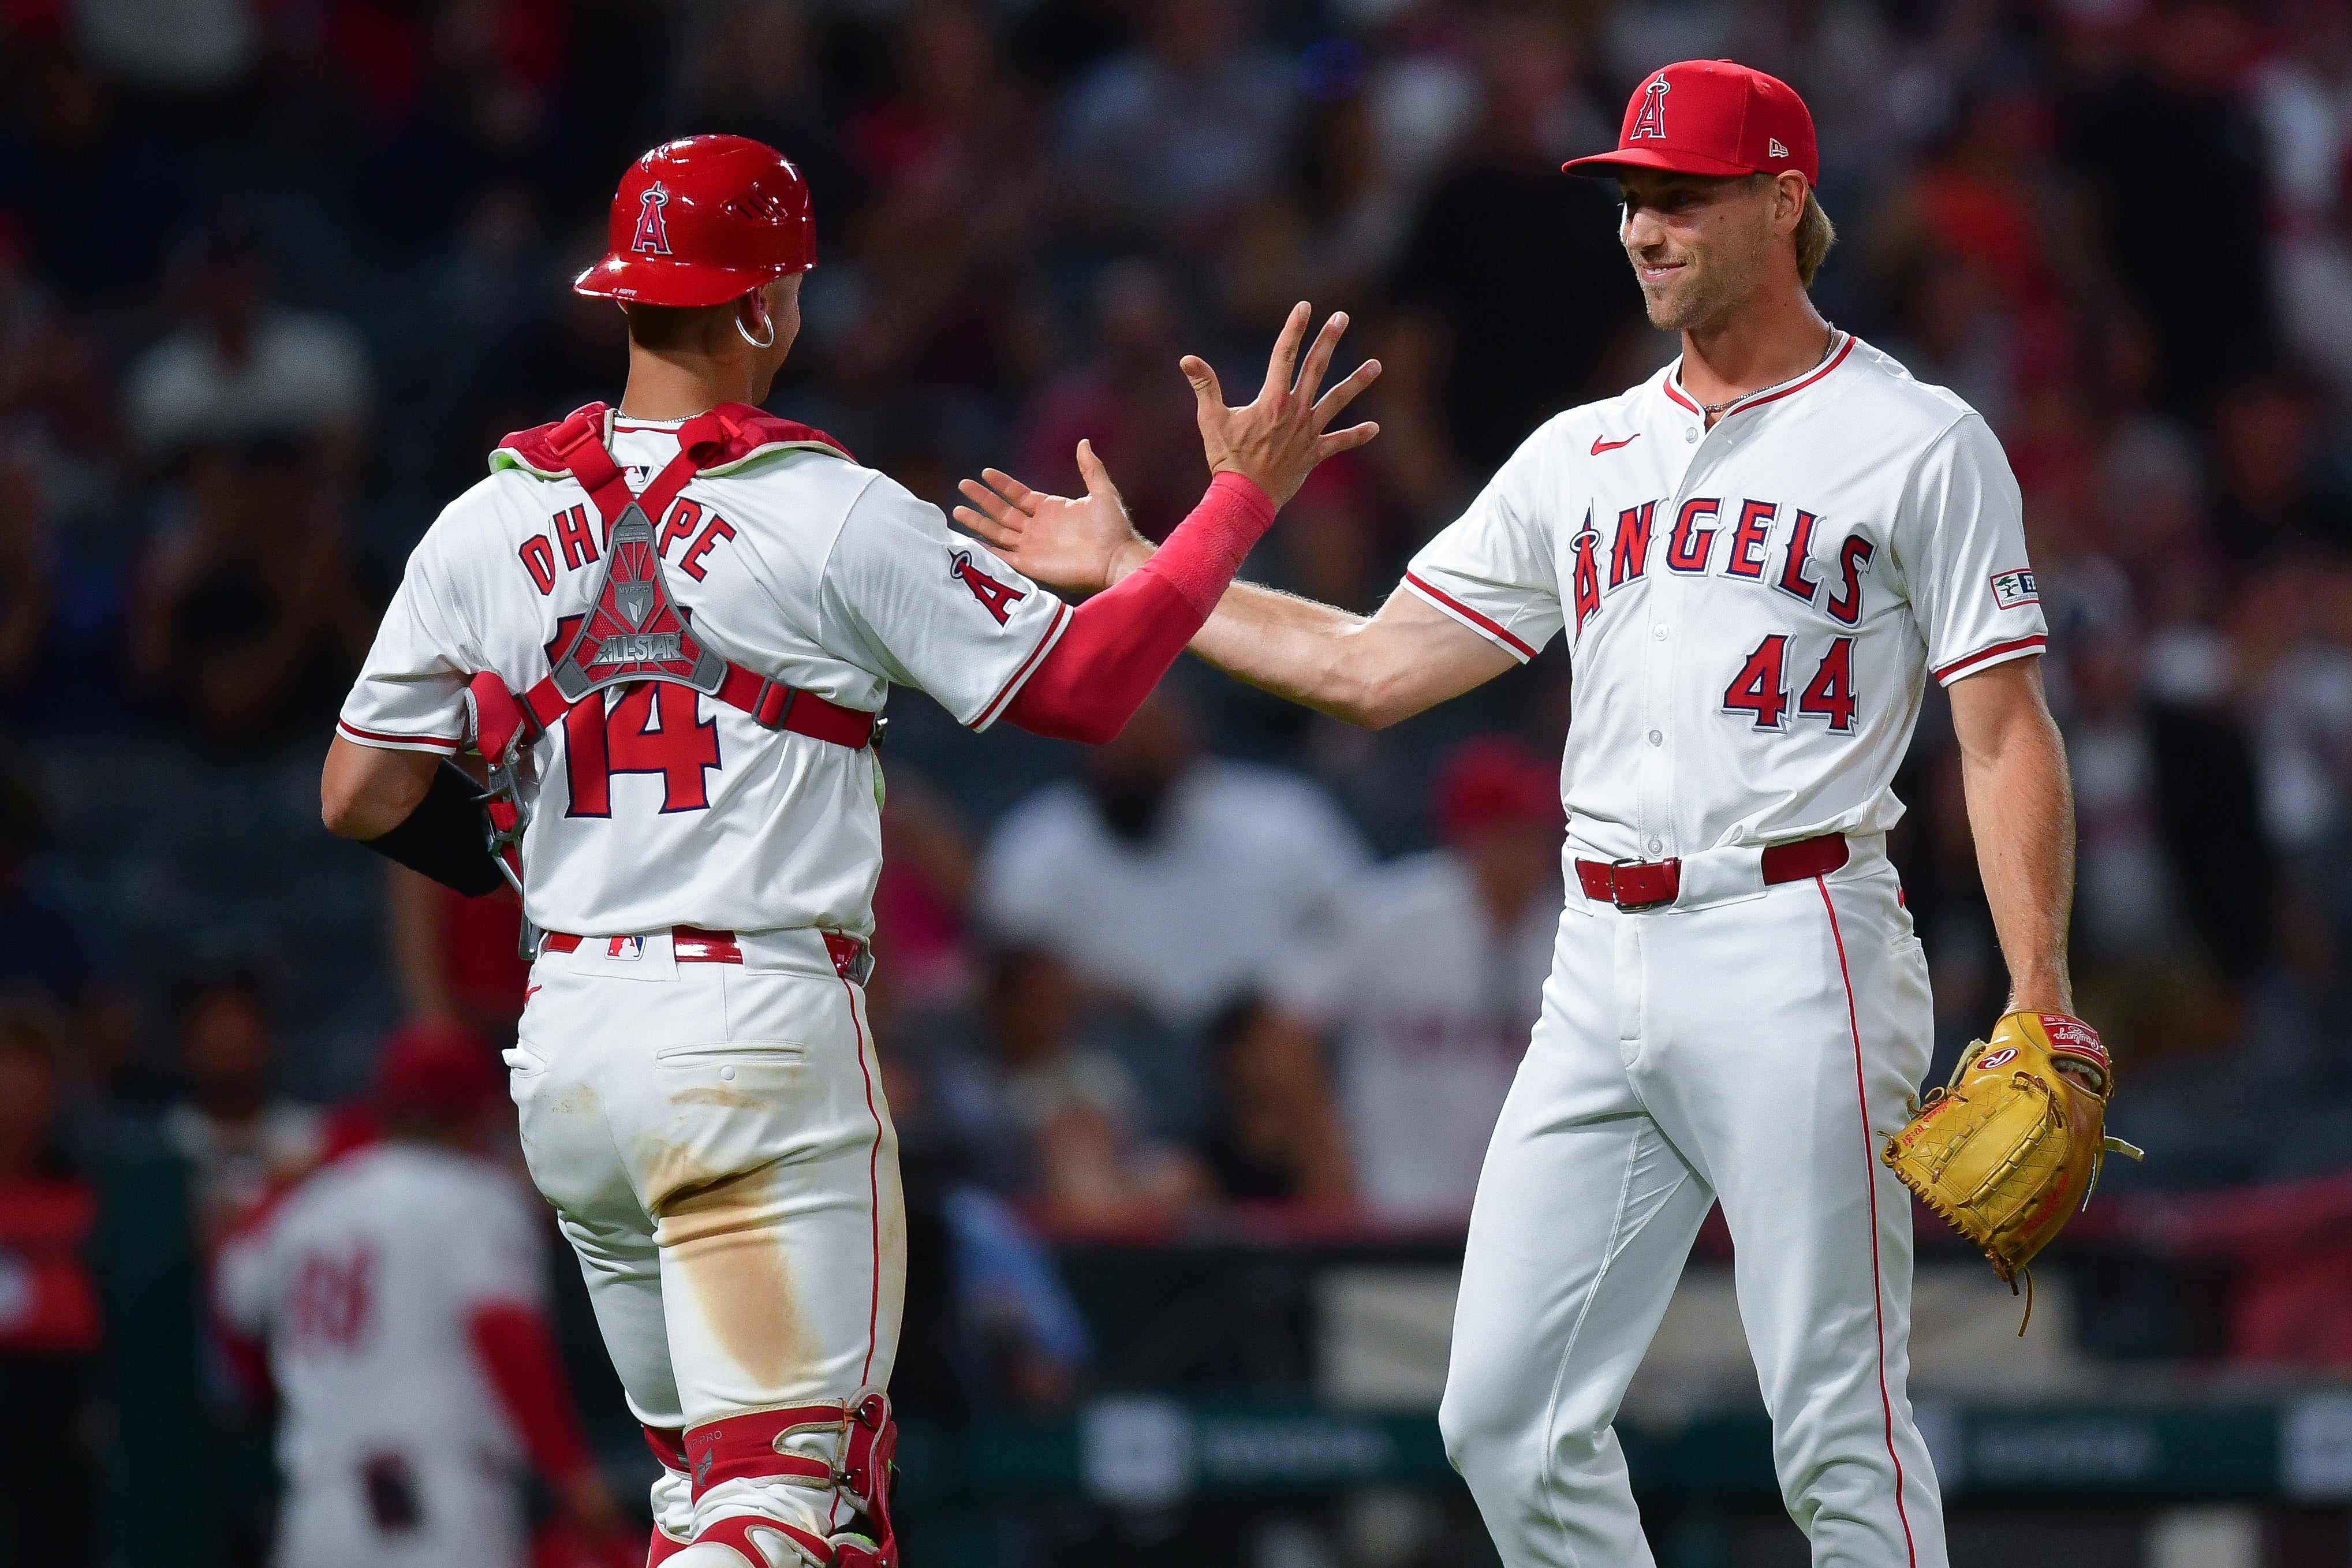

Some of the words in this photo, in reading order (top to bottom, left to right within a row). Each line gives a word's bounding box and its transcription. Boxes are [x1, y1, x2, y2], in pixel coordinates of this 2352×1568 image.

[1630, 73, 1667, 140] A
[632, 181, 673, 255] A
[1569, 496, 1875, 649] ANGELS
[592, 634, 681, 663] ALL-STAR
[1722, 633, 1856, 730] 44
[2053, 1026, 2099, 1051] Rawlings
